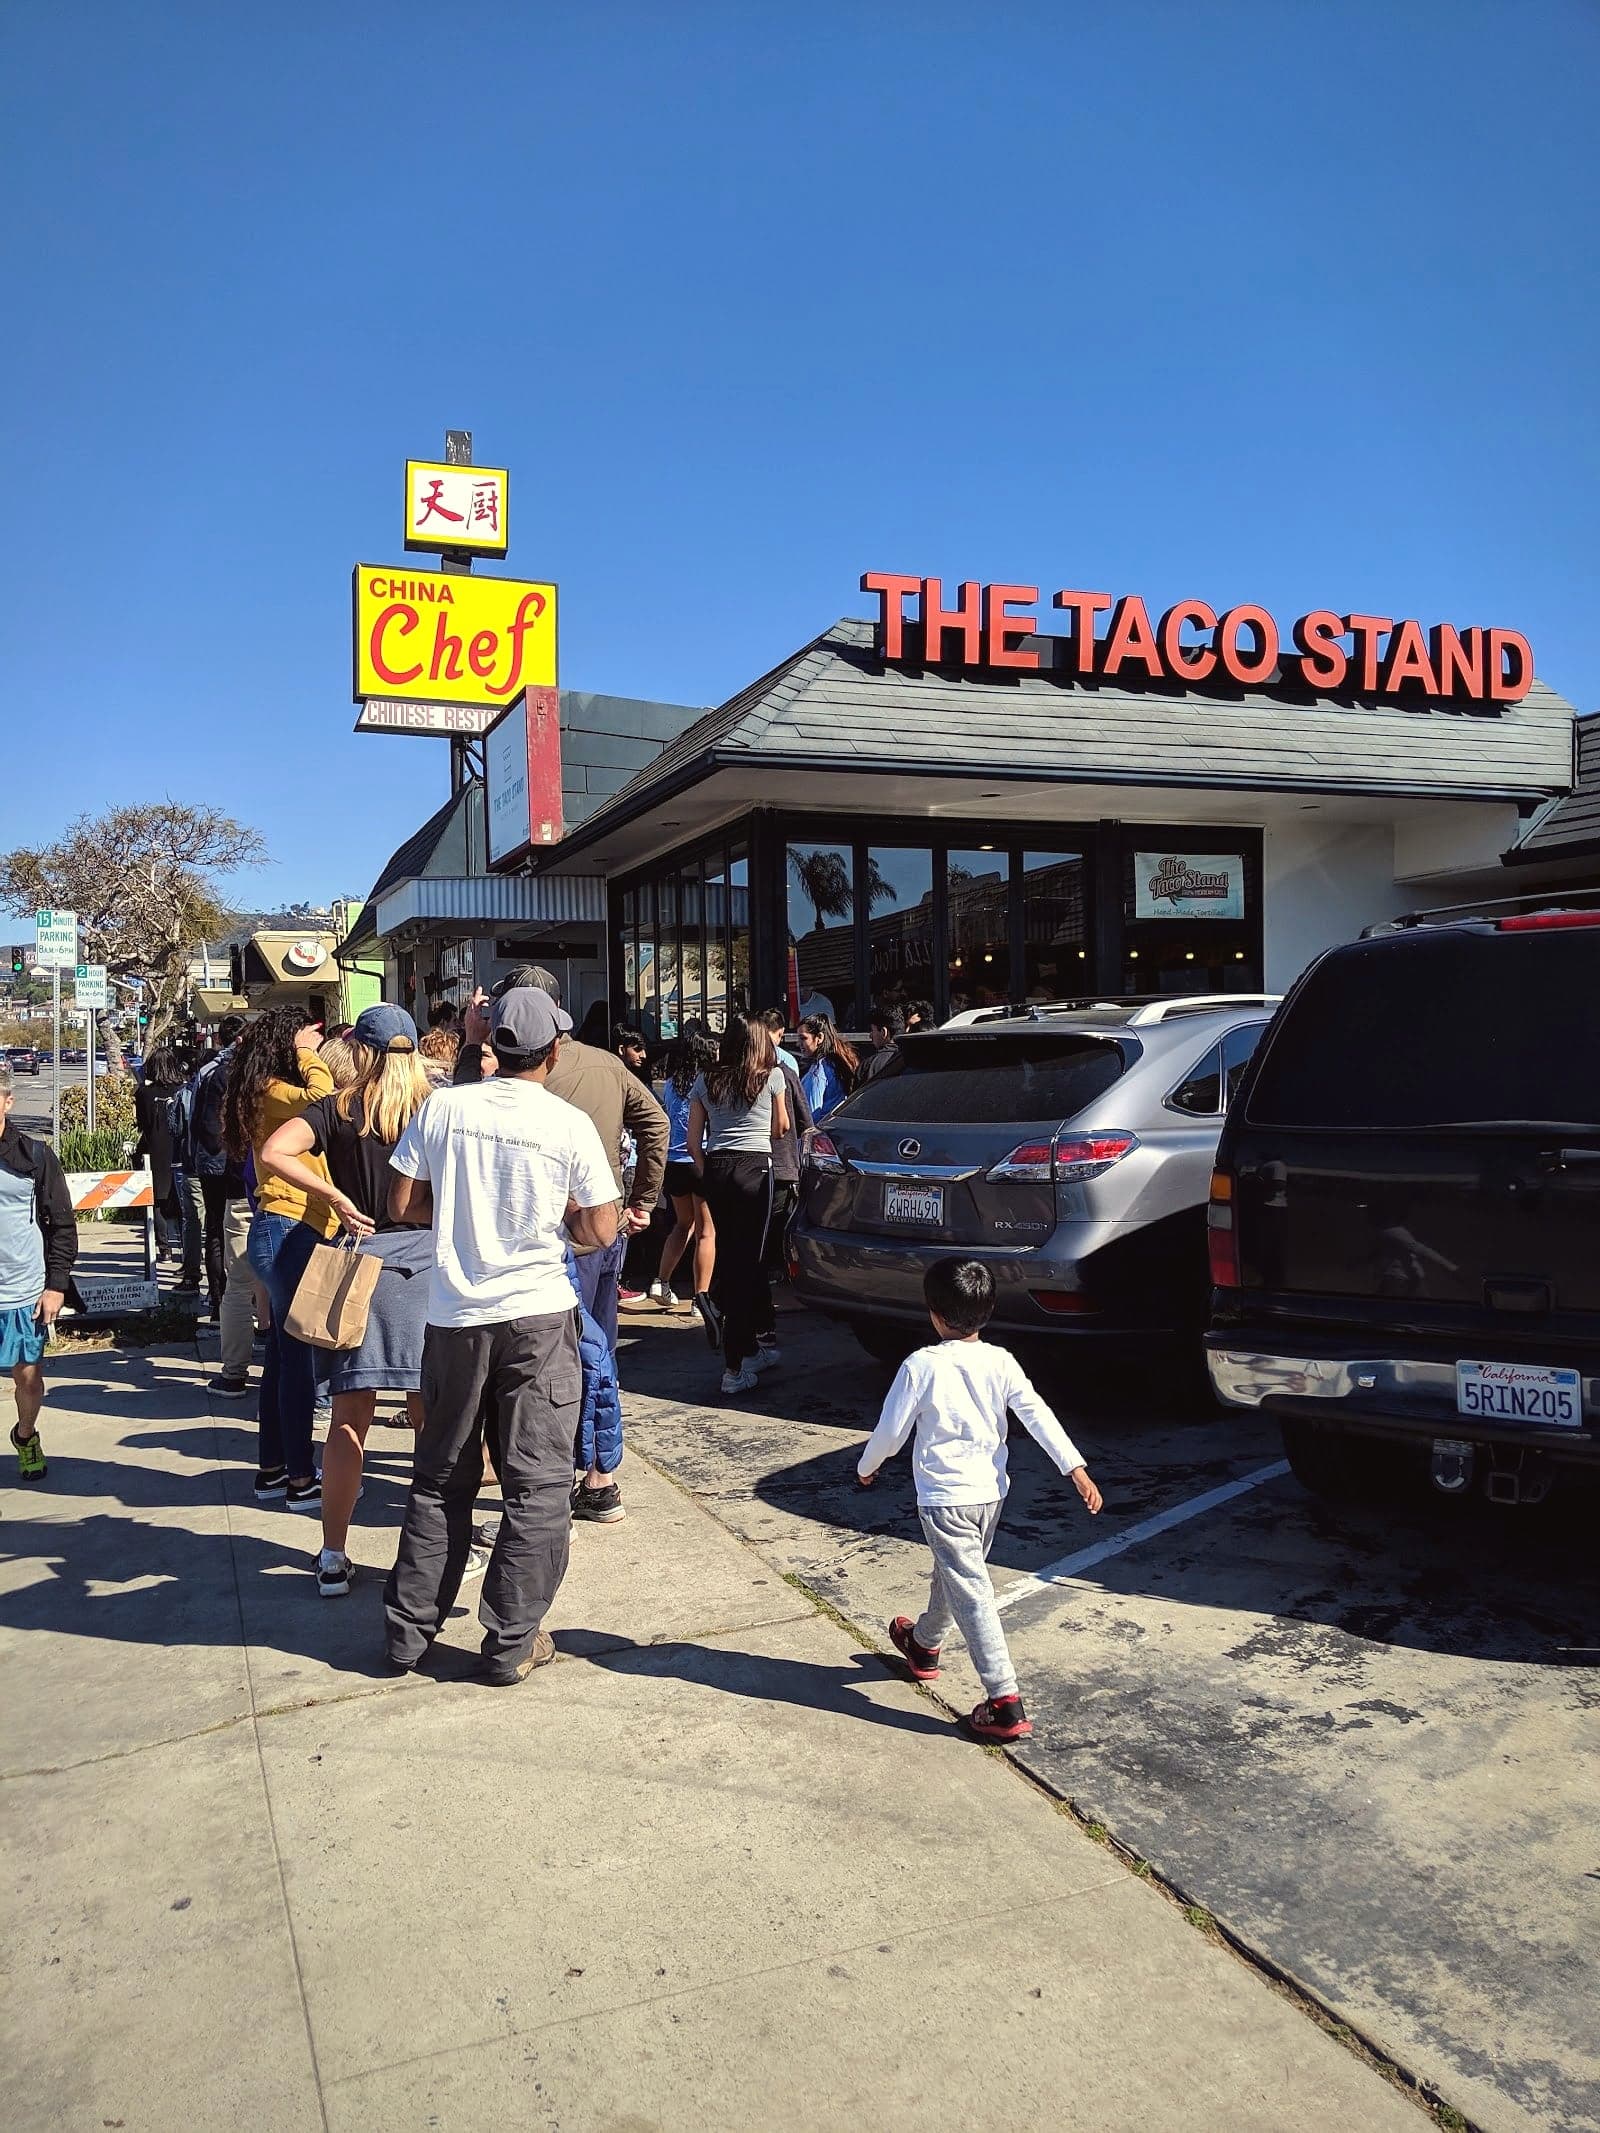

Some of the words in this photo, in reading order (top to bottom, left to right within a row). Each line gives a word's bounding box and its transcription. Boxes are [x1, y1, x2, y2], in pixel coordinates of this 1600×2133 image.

[369, 577, 455, 605] CHINA
[369, 591, 547, 696] Chef
[860, 570, 1040, 668] THE
[1053, 588, 1280, 684] TACO
[1295, 609, 1534, 704] STAND
[367, 700, 436, 727] CHINESE
[1158, 856, 1187, 880] The
[1149, 875, 1182, 900] Taco
[1184, 869, 1229, 889] Stand
[38, 913, 50, 926] 15
[53, 917, 74, 927] MINUTE
[40, 931, 74, 943] PARKING
[78, 967, 86, 977] 2
[89, 969, 104, 977] HOUR
[78, 980, 104, 989] PARKING
[452, 1127, 465, 1136] work
[481, 1132, 494, 1142] have
[505, 1137, 521, 1147] make
[888, 1198, 939, 1219] 6WRH490
[97, 1288, 115, 1296] SAN
[117, 1285, 145, 1294] DIEGO
[101, 1292, 141, 1302] DIVISION
[1482, 1364, 1557, 1385] California
[1464, 1382, 1573, 1420] 5RIN205
